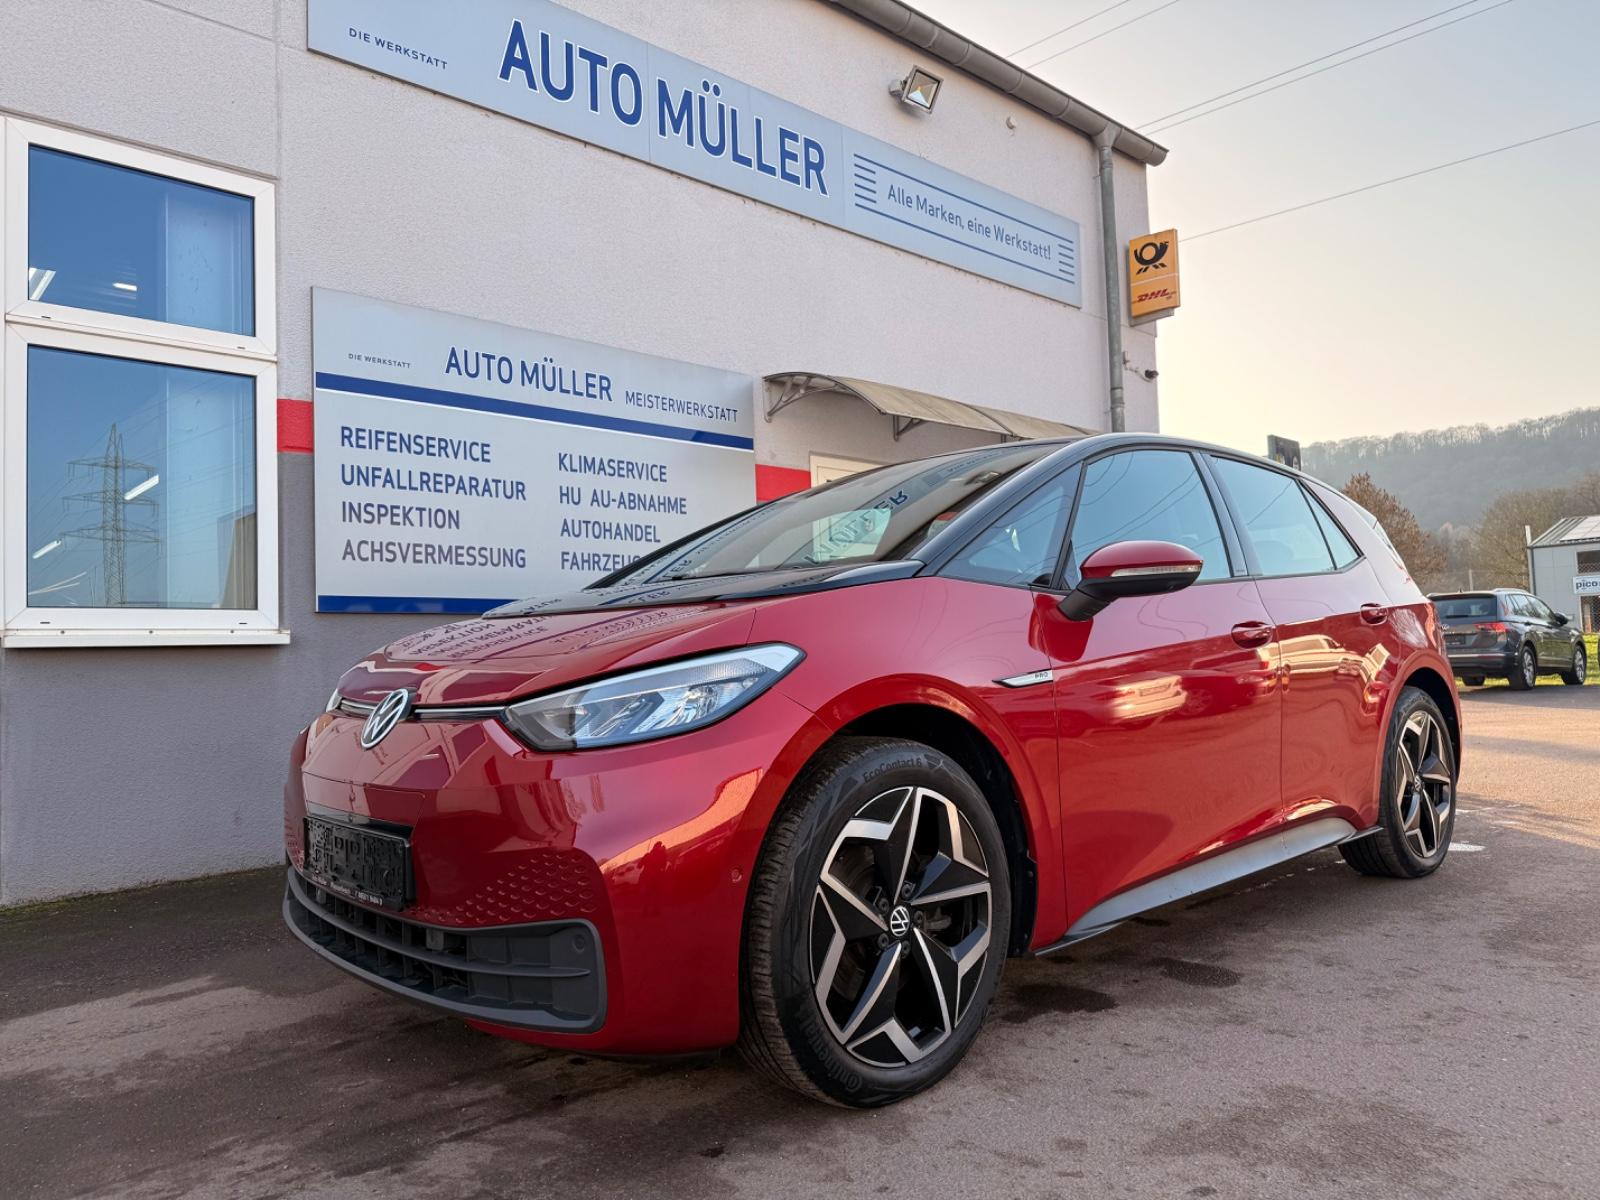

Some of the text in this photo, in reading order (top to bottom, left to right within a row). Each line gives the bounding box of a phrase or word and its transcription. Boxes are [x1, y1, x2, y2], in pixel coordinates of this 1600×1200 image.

[349, 27, 448, 70] DIE WERKSTATT
[499, 18, 829, 198] AUTO MÜLLER
[888, 184, 1052, 260] Alle Marken, eine Werkstatt!
[1137, 288, 1169, 303] DHL
[348, 353, 410, 369] DIE WERKSTATT
[445, 346, 613, 402] AUTO MÜLLER
[625, 390, 738, 423] MEISTERWERKSTATT
[341, 426, 492, 463] REIFENSERVICE
[341, 463, 527, 501] UNFALLREPARATUR
[558, 452, 668, 483] KLIMASERVICE
[342, 500, 460, 530] INSPEKTION
[559, 485, 687, 515] HU AU-ABNAHME
[560, 518, 661, 543] AUTOHANDEL
[342, 538, 527, 569] ACHSVERMESSUNG
[1576, 580, 1600, 590] pico
